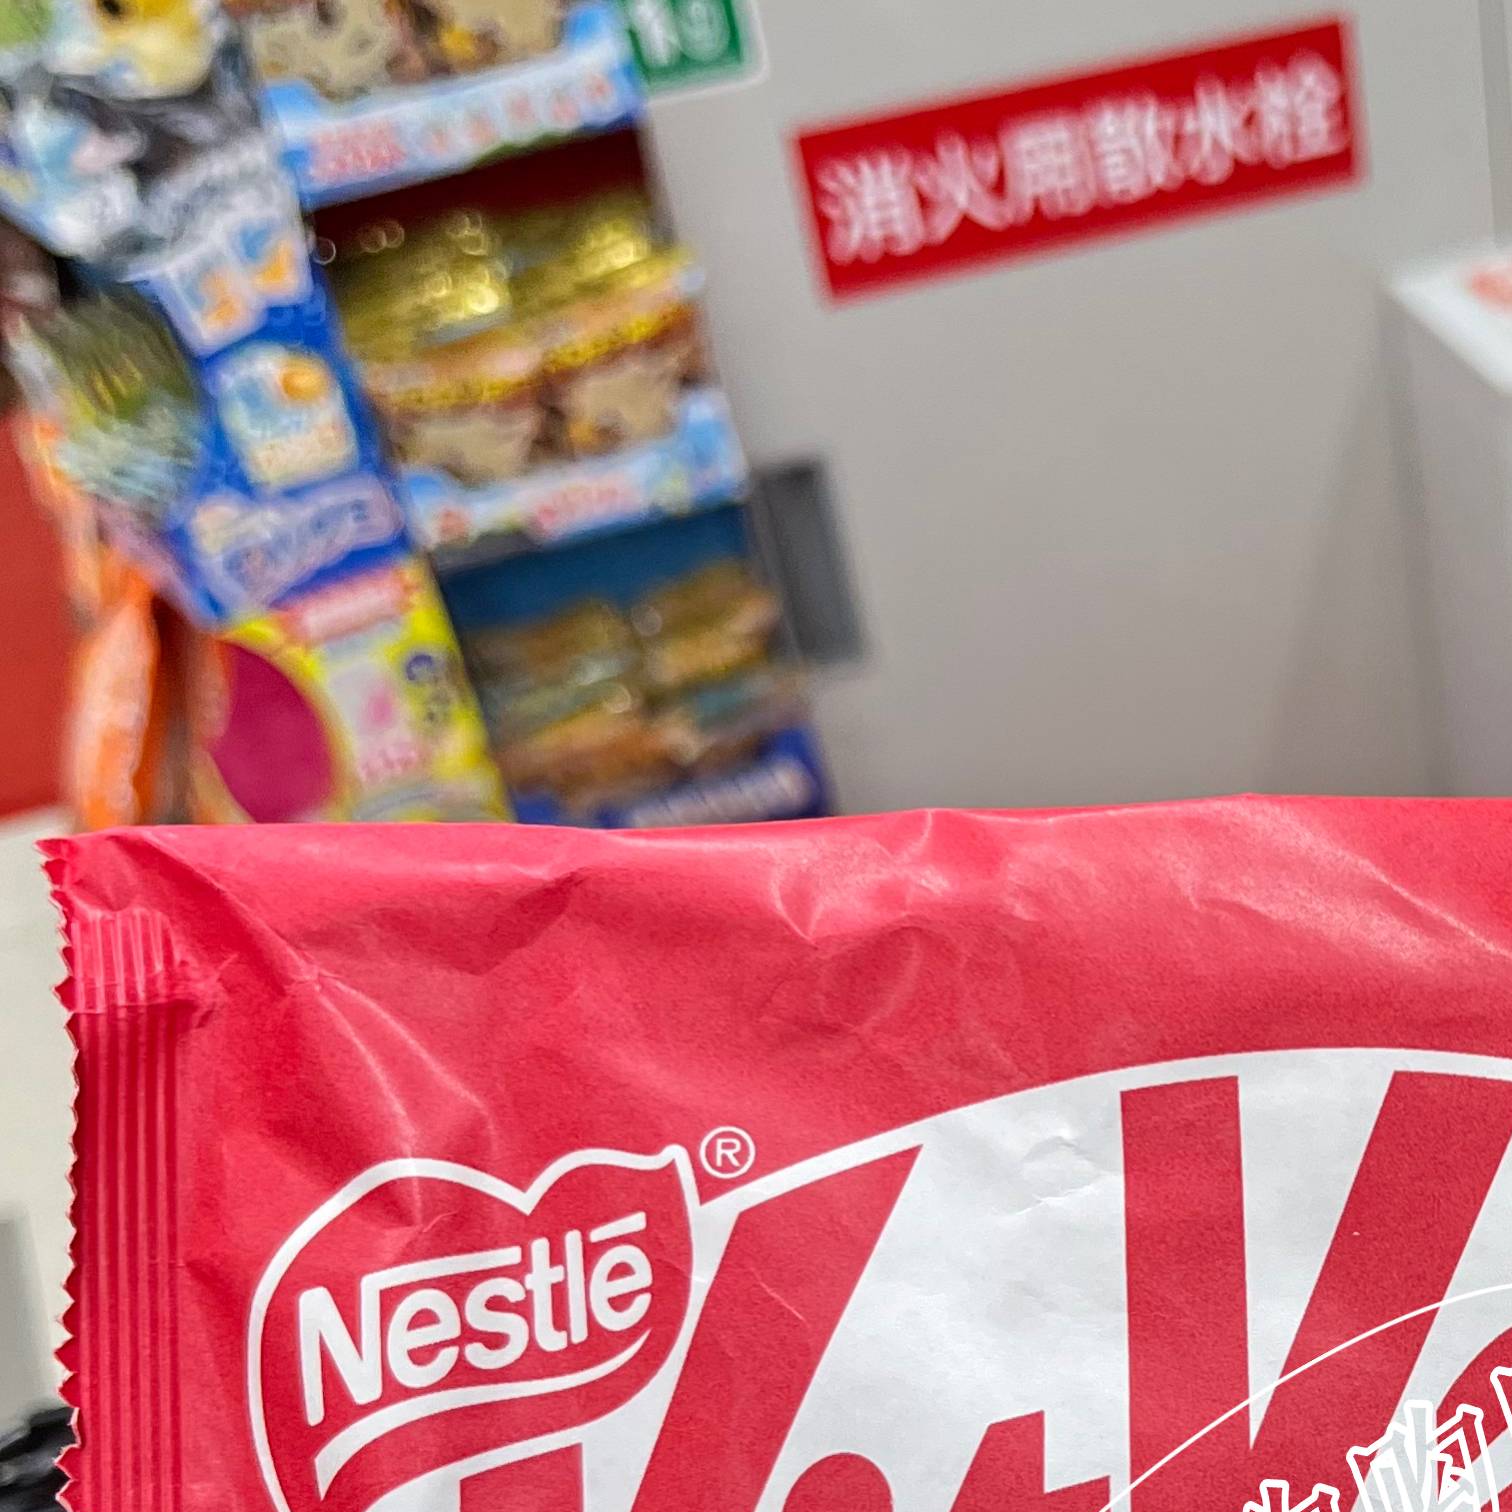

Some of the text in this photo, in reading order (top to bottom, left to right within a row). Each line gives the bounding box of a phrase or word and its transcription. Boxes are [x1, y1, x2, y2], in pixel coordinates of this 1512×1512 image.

[817, 50, 1349, 265] 消火用散水栓
